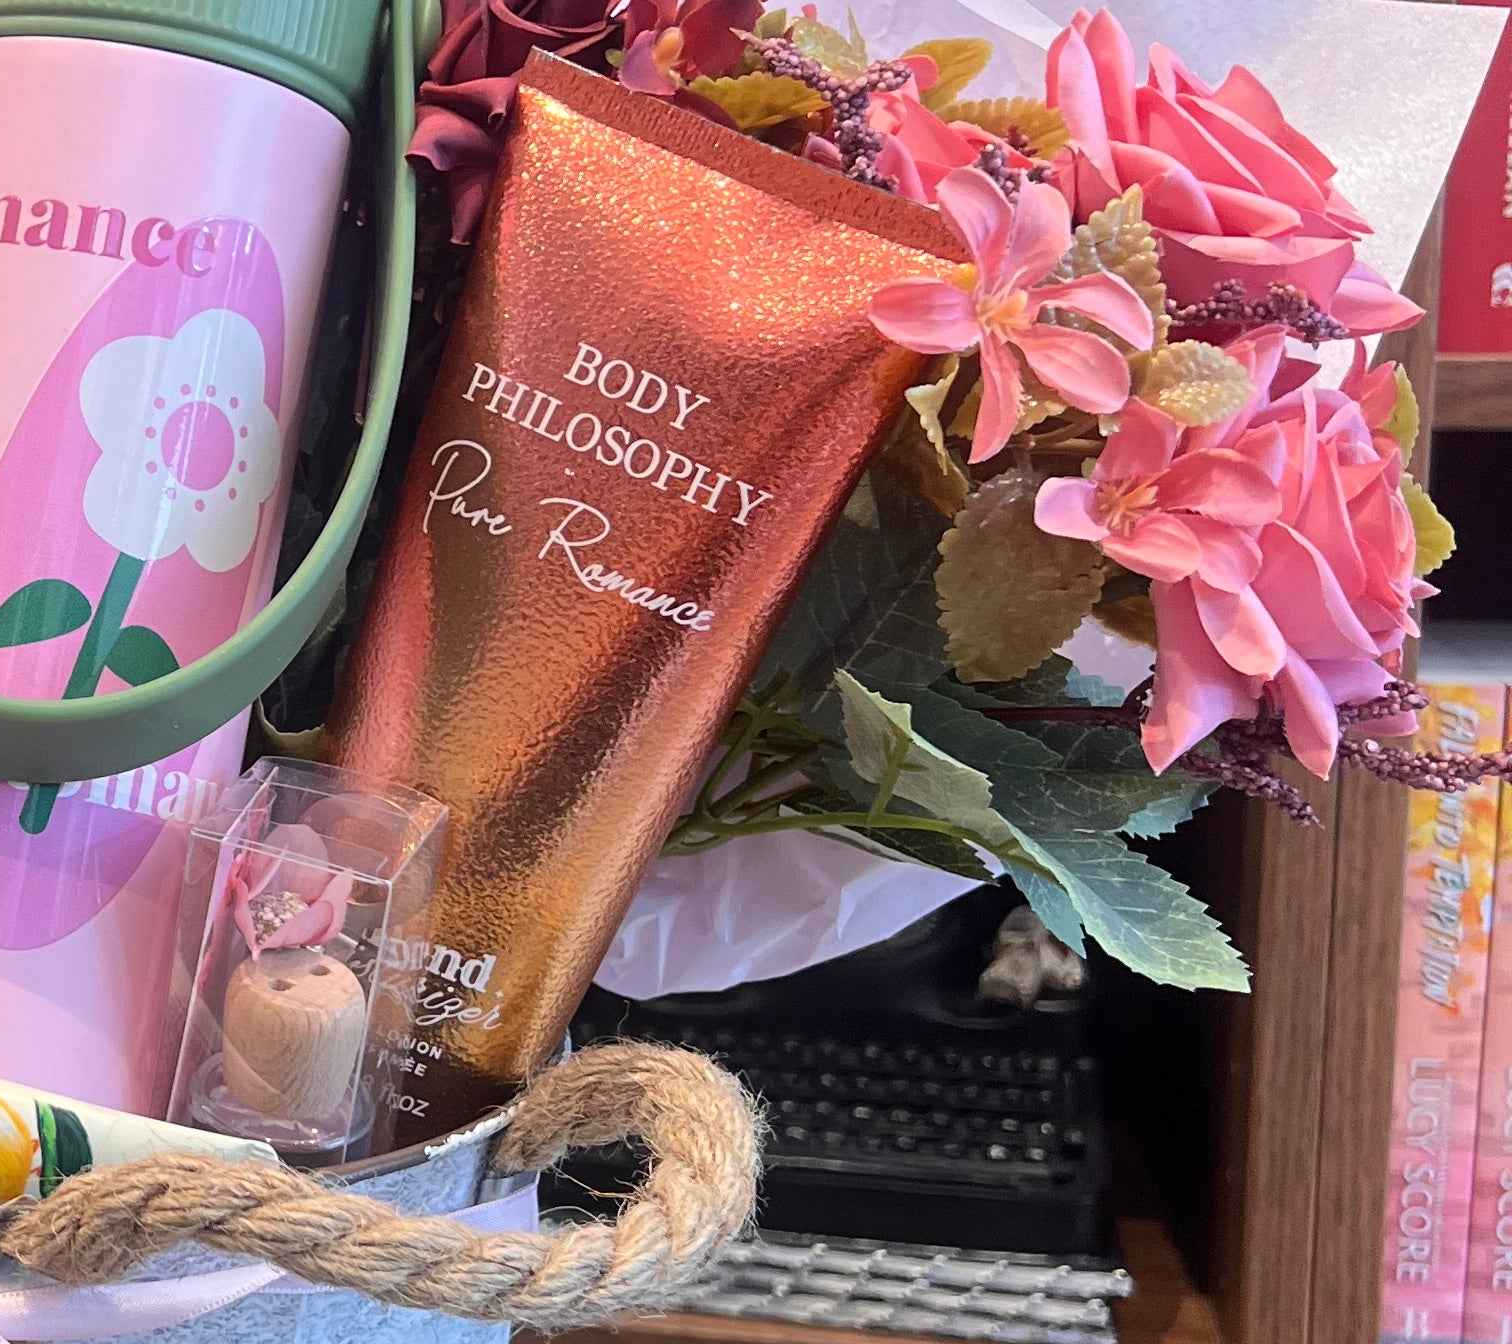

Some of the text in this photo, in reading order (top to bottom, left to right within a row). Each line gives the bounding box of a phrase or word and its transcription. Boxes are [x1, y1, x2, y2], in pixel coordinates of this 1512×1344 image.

[563, 342, 710, 431] BODY
[462, 362, 774, 527] PHILOSOPHY
[423, 439, 716, 632] Pure Romance
[1438, 702, 1480, 754] FAL
[1404, 1056, 1449, 1156] LUCY
[1396, 1163, 1435, 1285] SCORE
